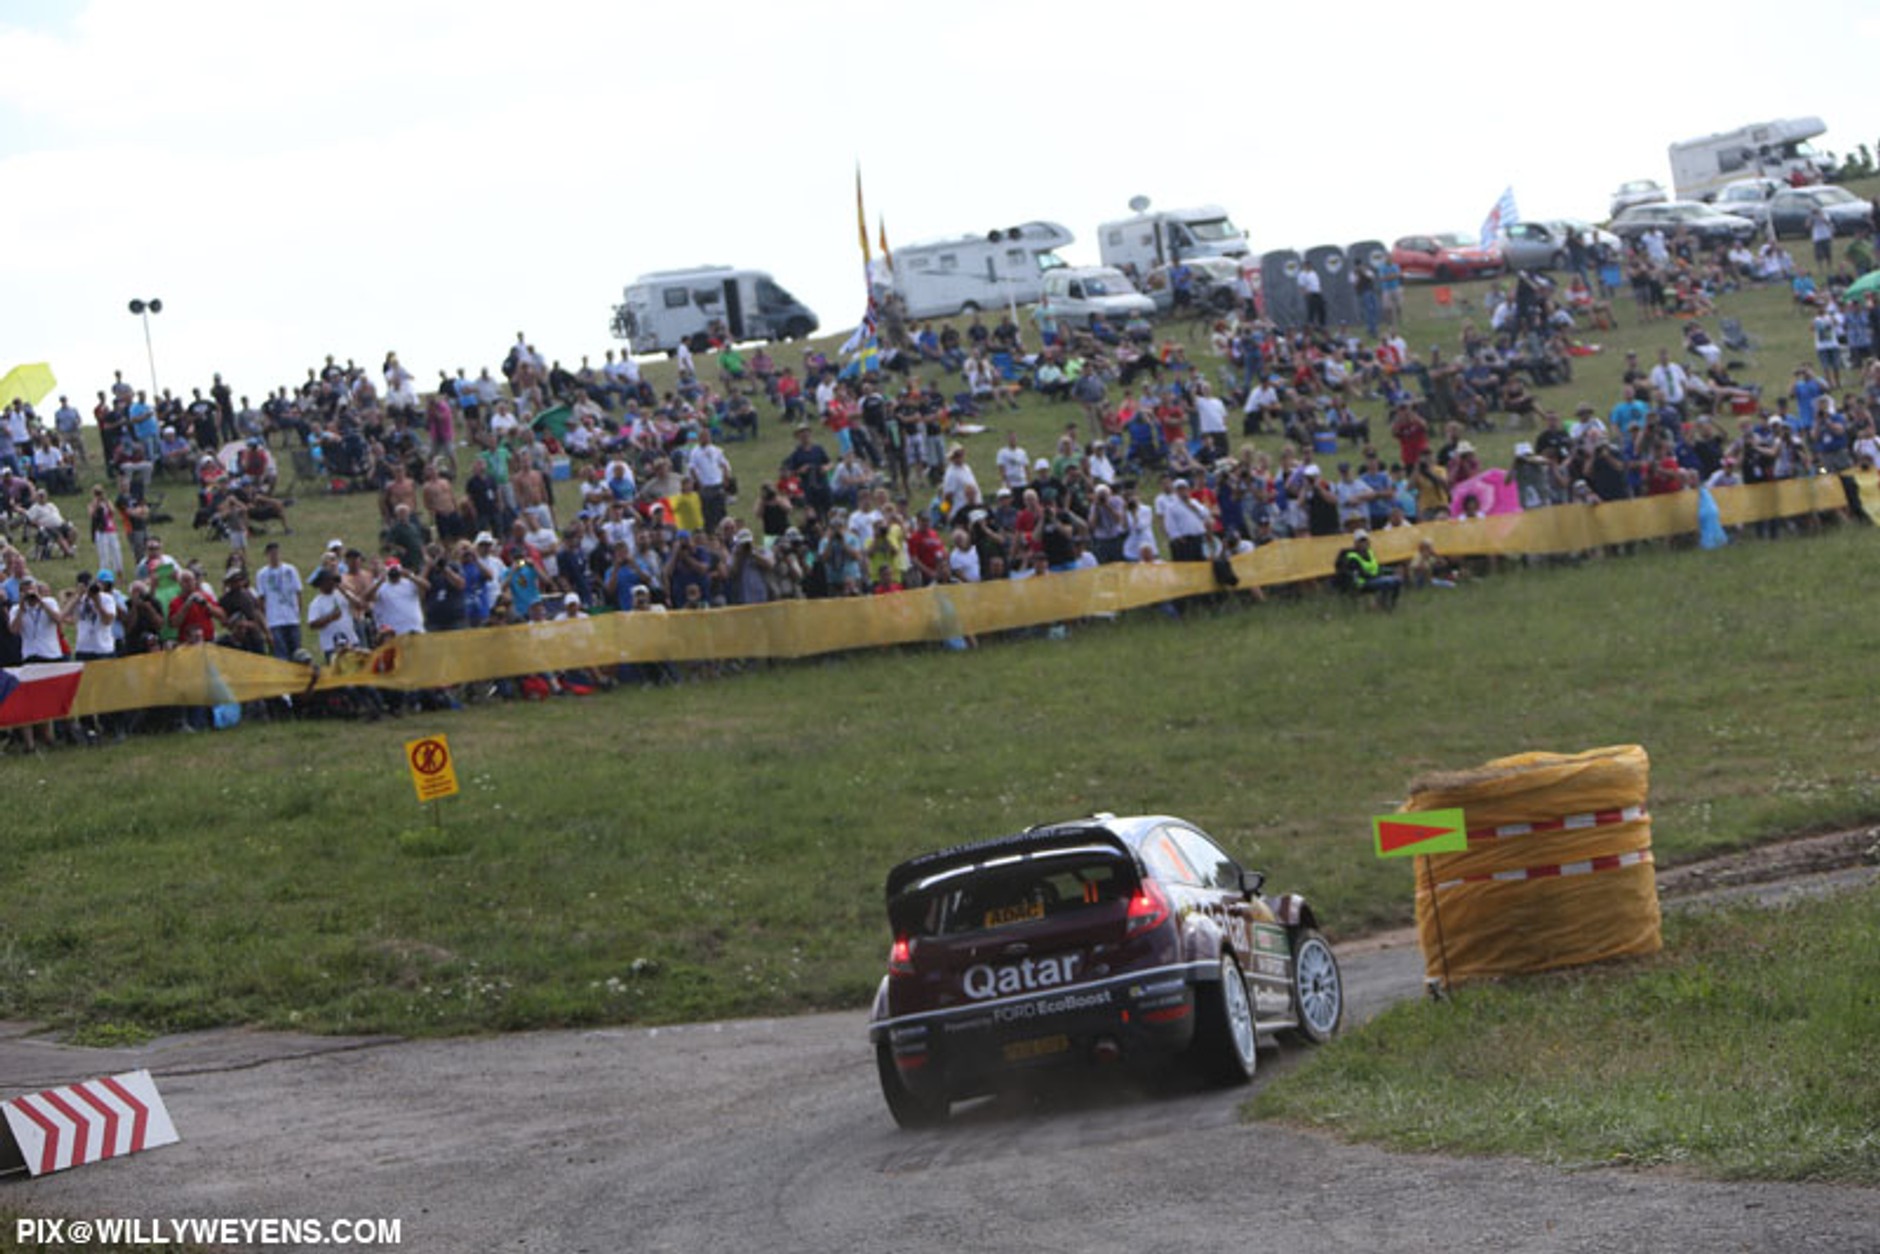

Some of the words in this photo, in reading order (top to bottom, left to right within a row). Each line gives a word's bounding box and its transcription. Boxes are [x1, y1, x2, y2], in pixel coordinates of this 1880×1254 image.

[963, 954, 1080, 999] Qatar
[993, 1003, 1036, 1023] FORD
[1037, 989, 1112, 1016] EcoBoost
